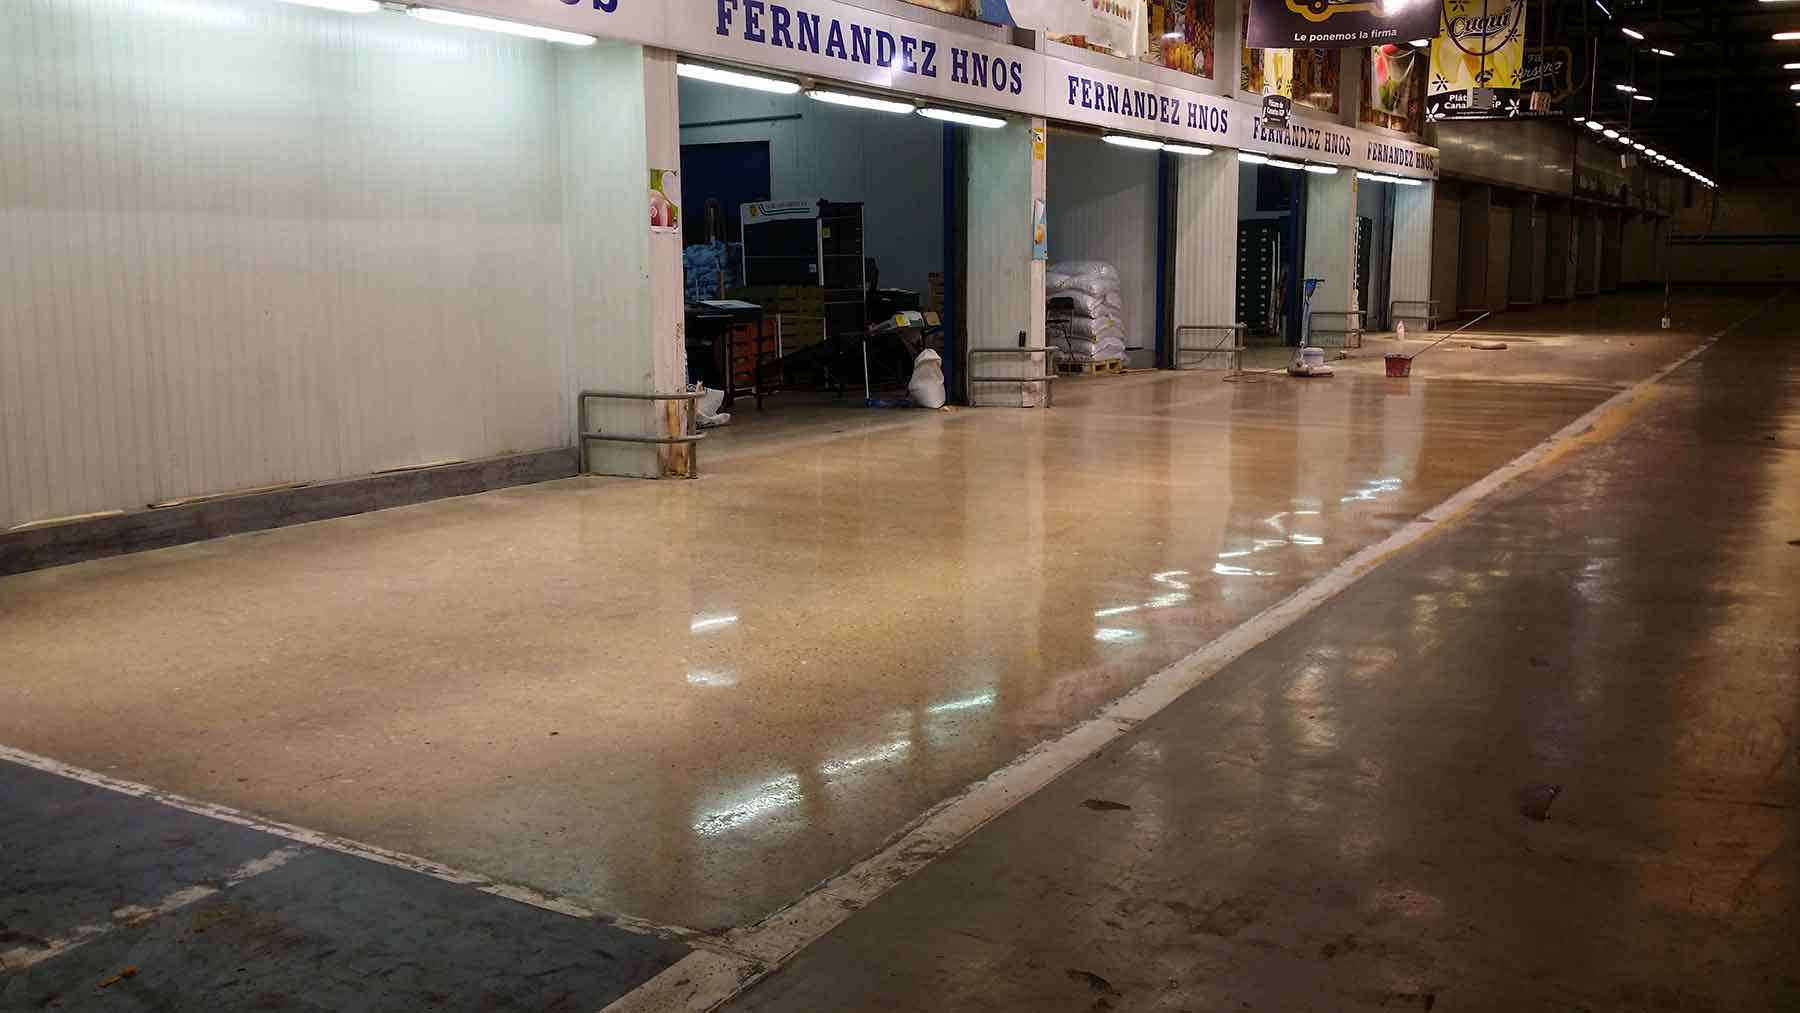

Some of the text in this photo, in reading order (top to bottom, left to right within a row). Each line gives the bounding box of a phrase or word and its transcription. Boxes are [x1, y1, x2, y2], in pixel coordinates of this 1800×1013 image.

[1294, 28, 1398, 43] Le ponemos la firma
[1449, 8, 1512, 38] Cuqui
[715, 0, 1022, 95] FERNANDEZ HNOS
[1068, 75, 1180, 125] FERNANDEZ
[1187, 102, 1229, 134] HNOS
[1324, 131, 1351, 157] HNOS
[1367, 141, 1435, 171] FERNANDEZ HNOS
